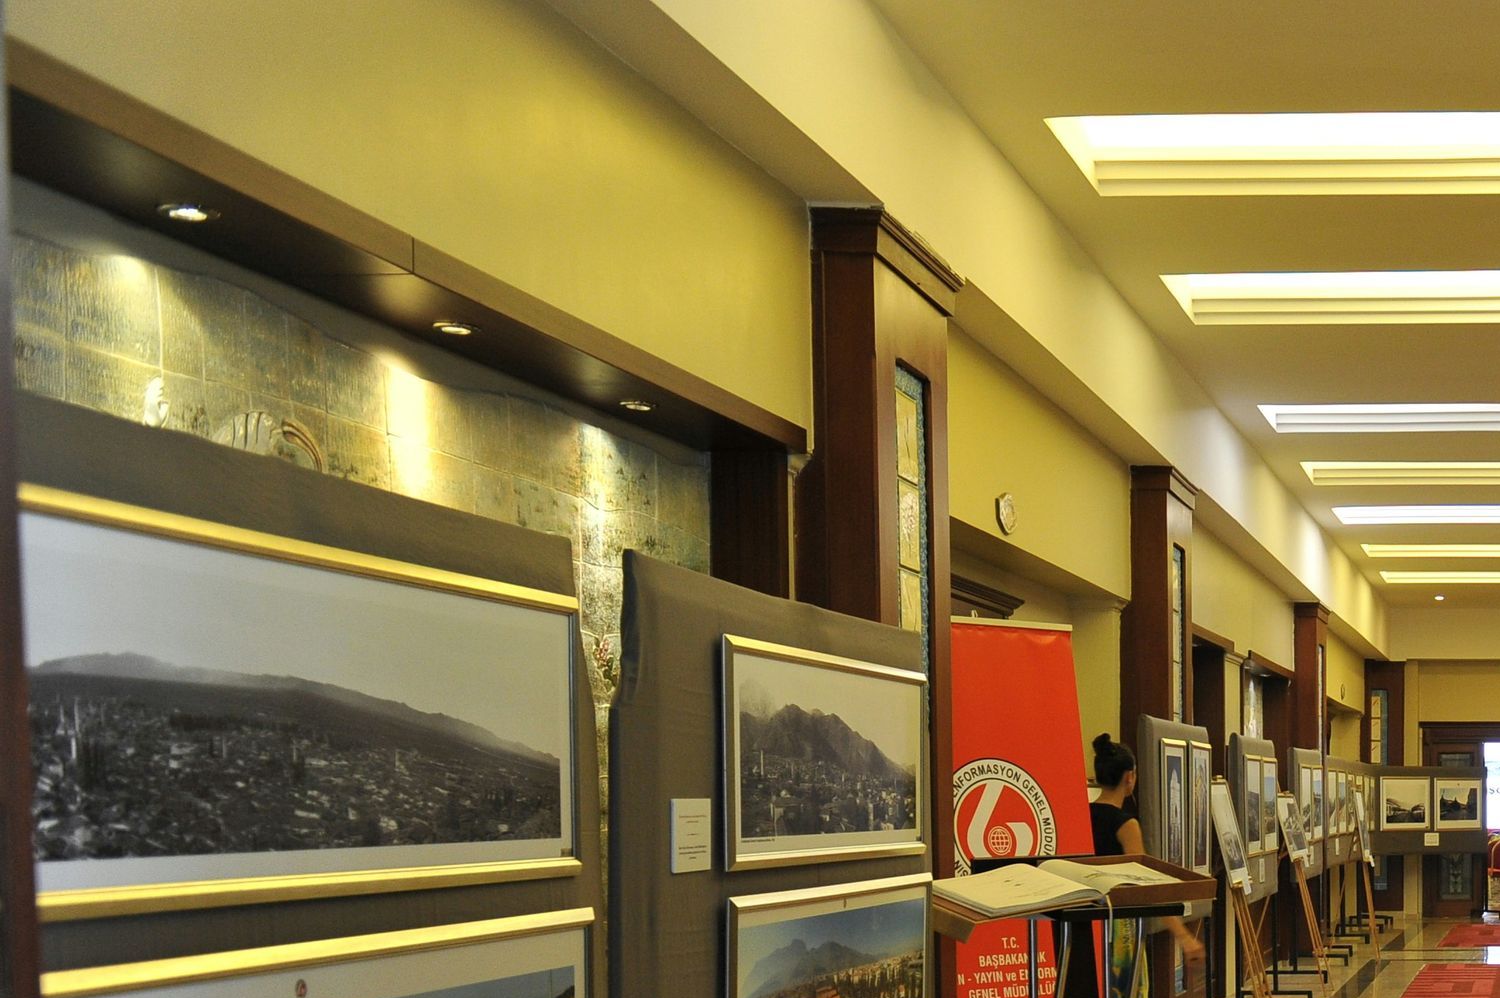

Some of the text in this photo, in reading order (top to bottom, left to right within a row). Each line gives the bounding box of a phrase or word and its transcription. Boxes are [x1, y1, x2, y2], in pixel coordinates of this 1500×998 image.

[1022, 779, 1046, 815] GENEL
[1001, 936, 1020, 949] T.C.
[979, 951, 1046, 970] BAŞBAKANIK
[974, 971, 1003, 985] YAYIN
[1005, 972, 1017, 982] ve
[1003, 981, 1056, 998] MÜDLÜ
